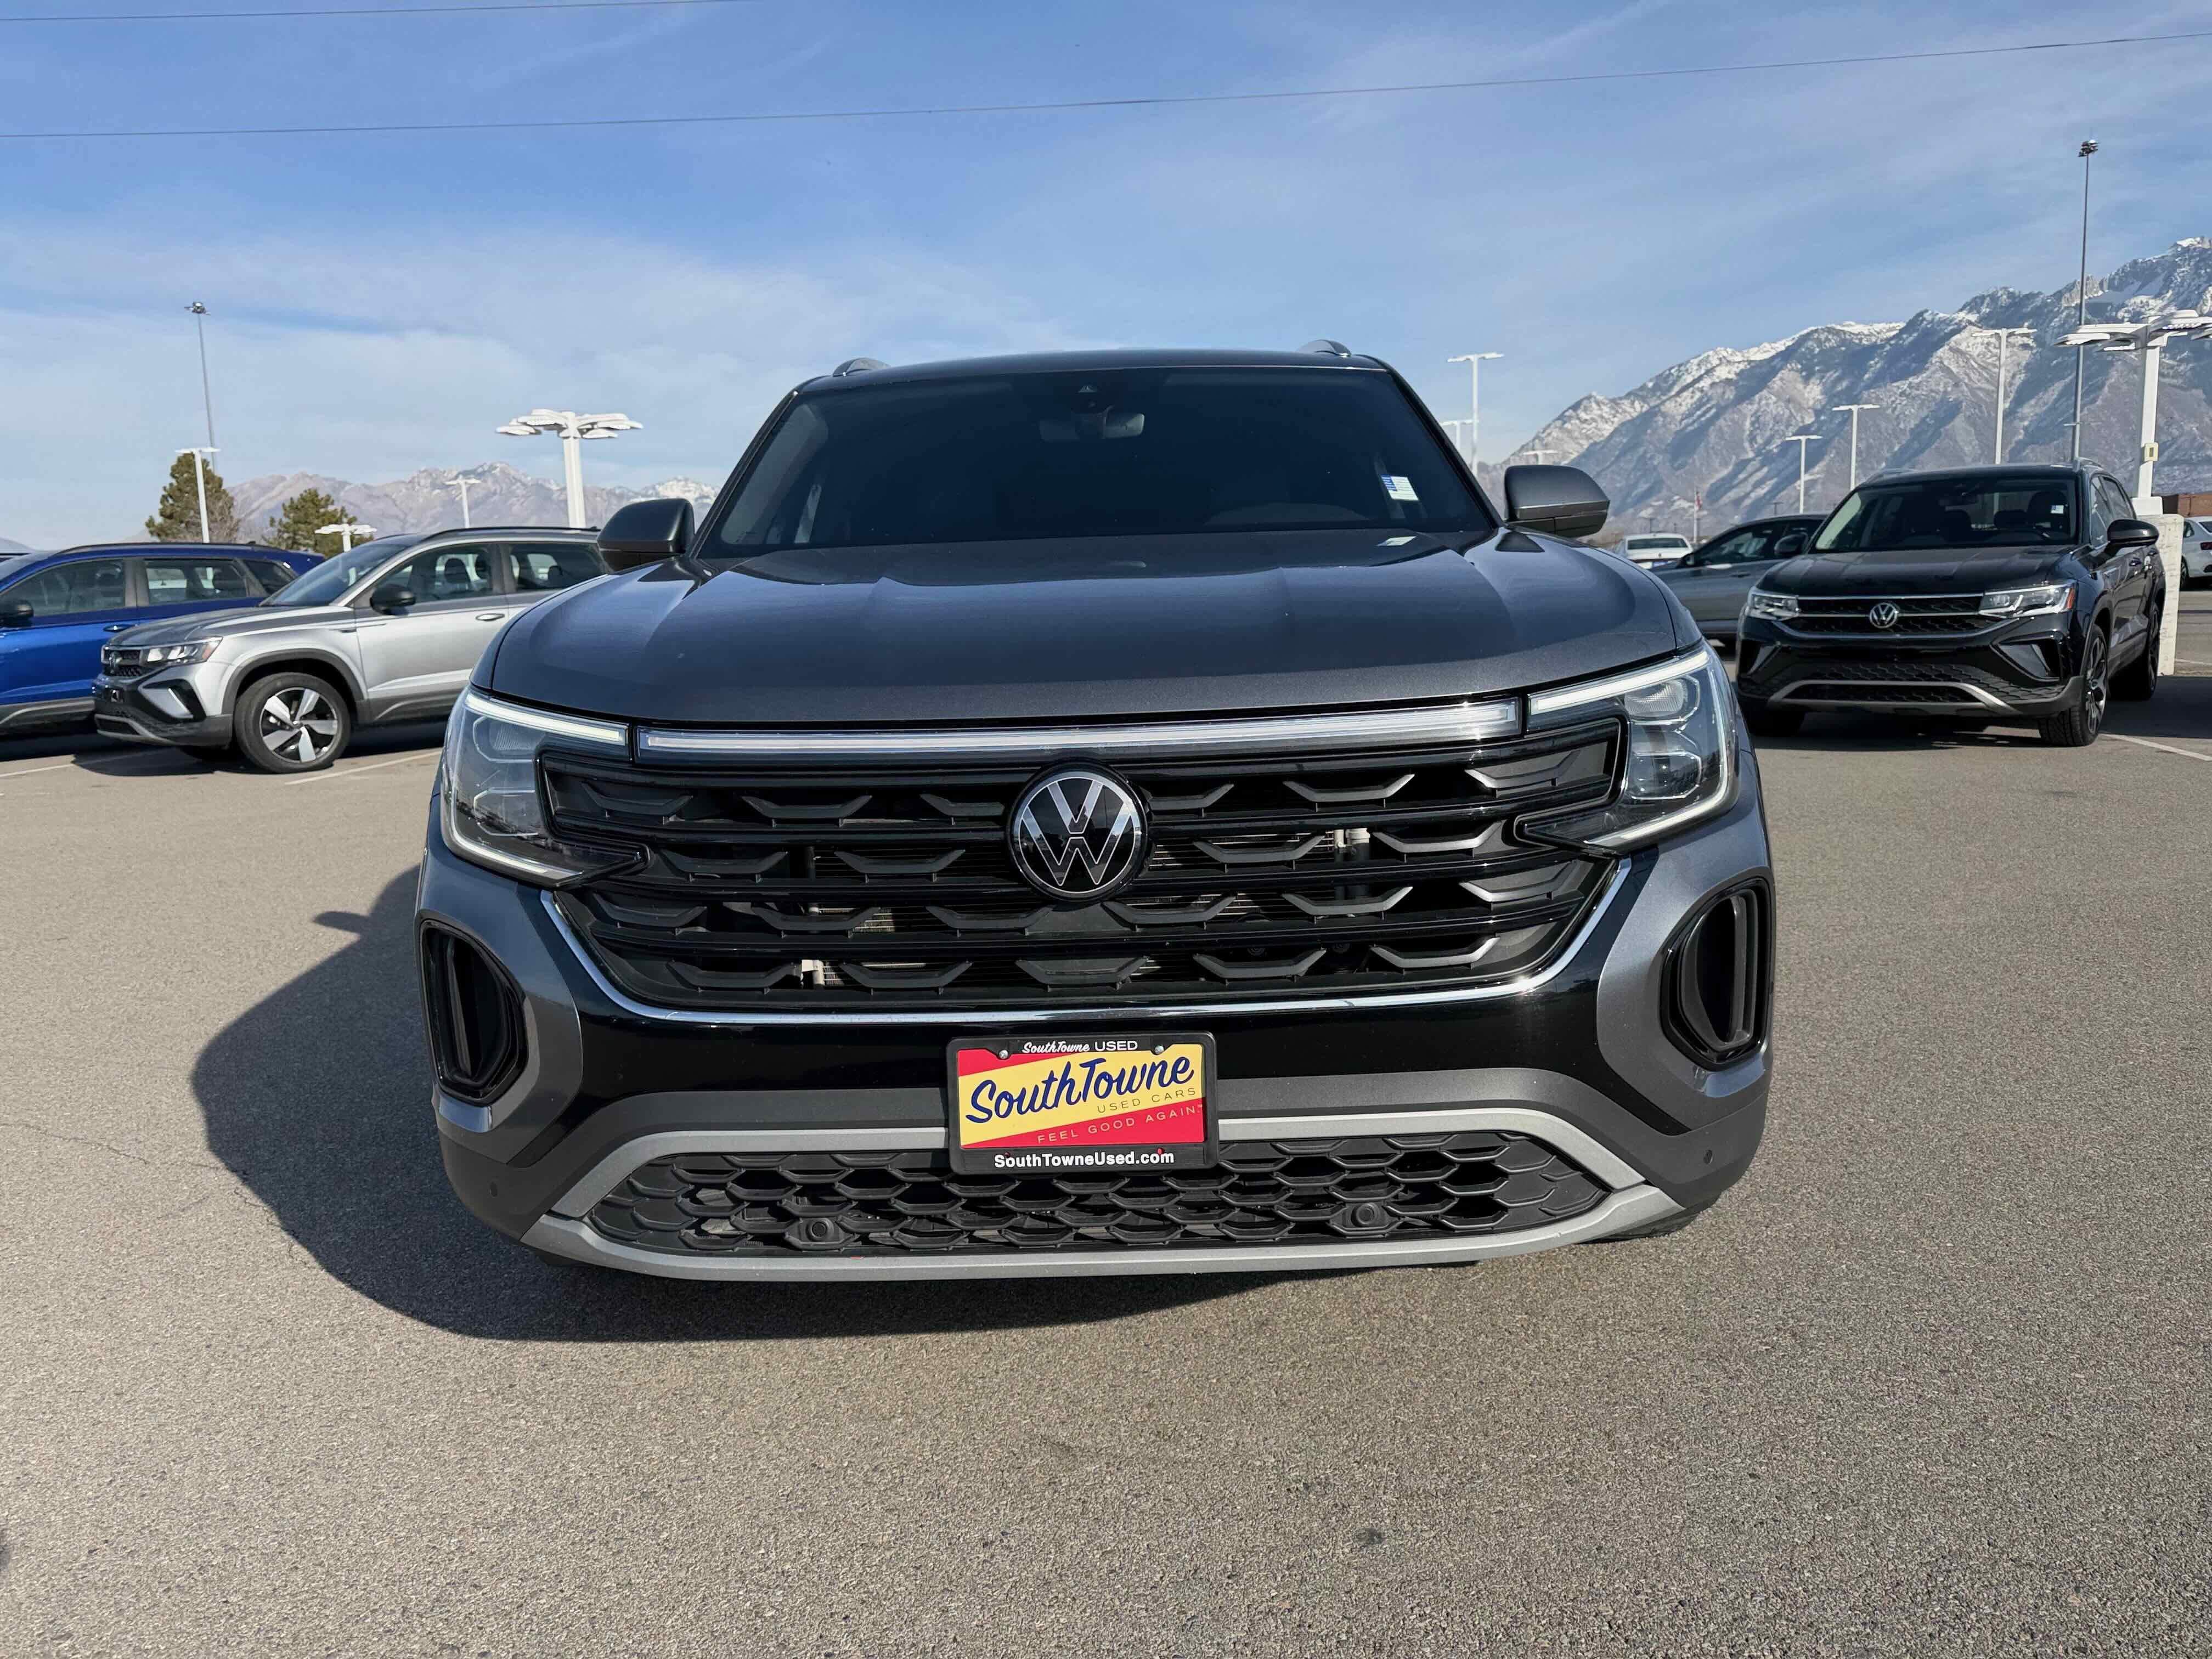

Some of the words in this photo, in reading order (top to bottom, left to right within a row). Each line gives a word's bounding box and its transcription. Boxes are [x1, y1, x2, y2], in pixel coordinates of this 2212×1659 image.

[1022, 1041, 1090, 1054] SouthTowne
[1094, 1041, 1138, 1052] USED
[966, 1056, 1194, 1123] SouthTowne
[1097, 1098, 1141, 1113] USED
[1152, 1087, 1197, 1103] CARS
[1037, 1130, 1079, 1144] FEEL
[1088, 1117, 1136, 1134] GOOD
[994, 1152, 1175, 1168] SouthTowneUsed.com
